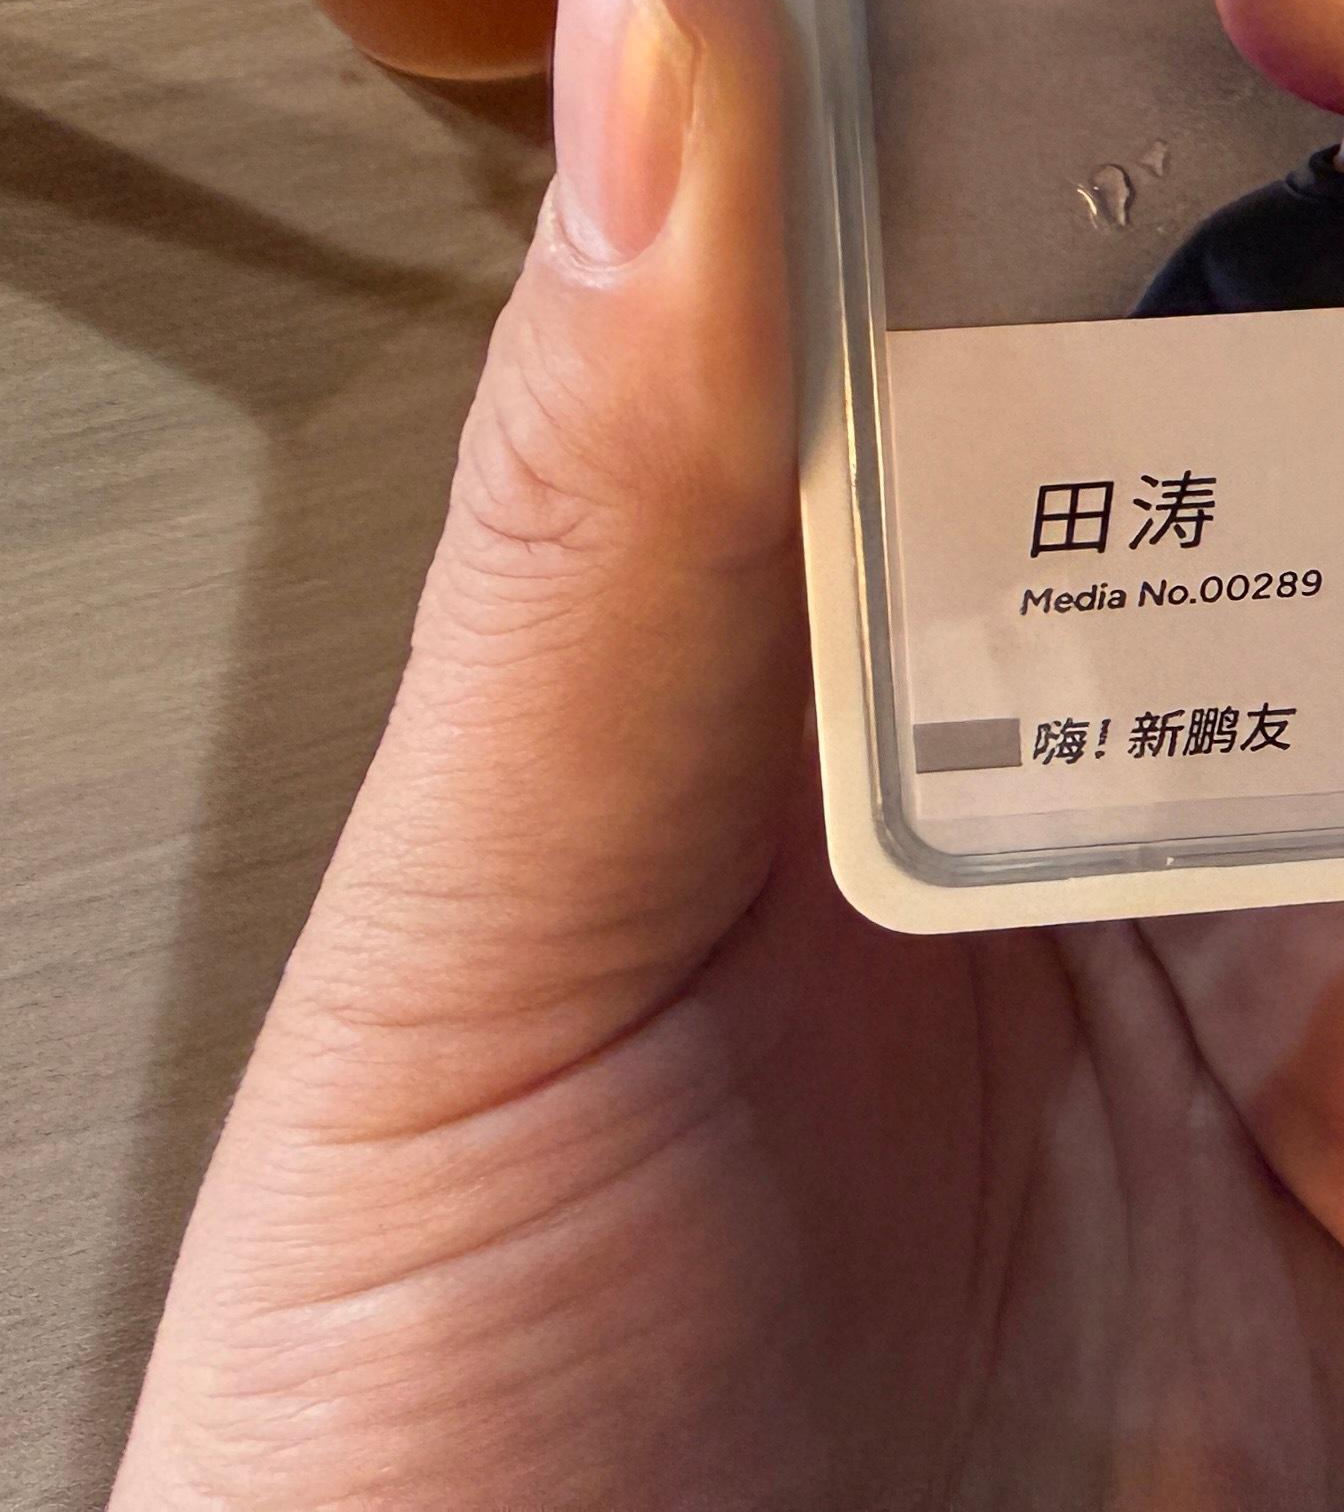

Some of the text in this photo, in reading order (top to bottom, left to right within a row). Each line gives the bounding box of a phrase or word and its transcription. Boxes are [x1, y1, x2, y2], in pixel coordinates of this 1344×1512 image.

[1030, 470, 1217, 558] 田涛
[1020, 569, 1322, 615] Media No.00289
